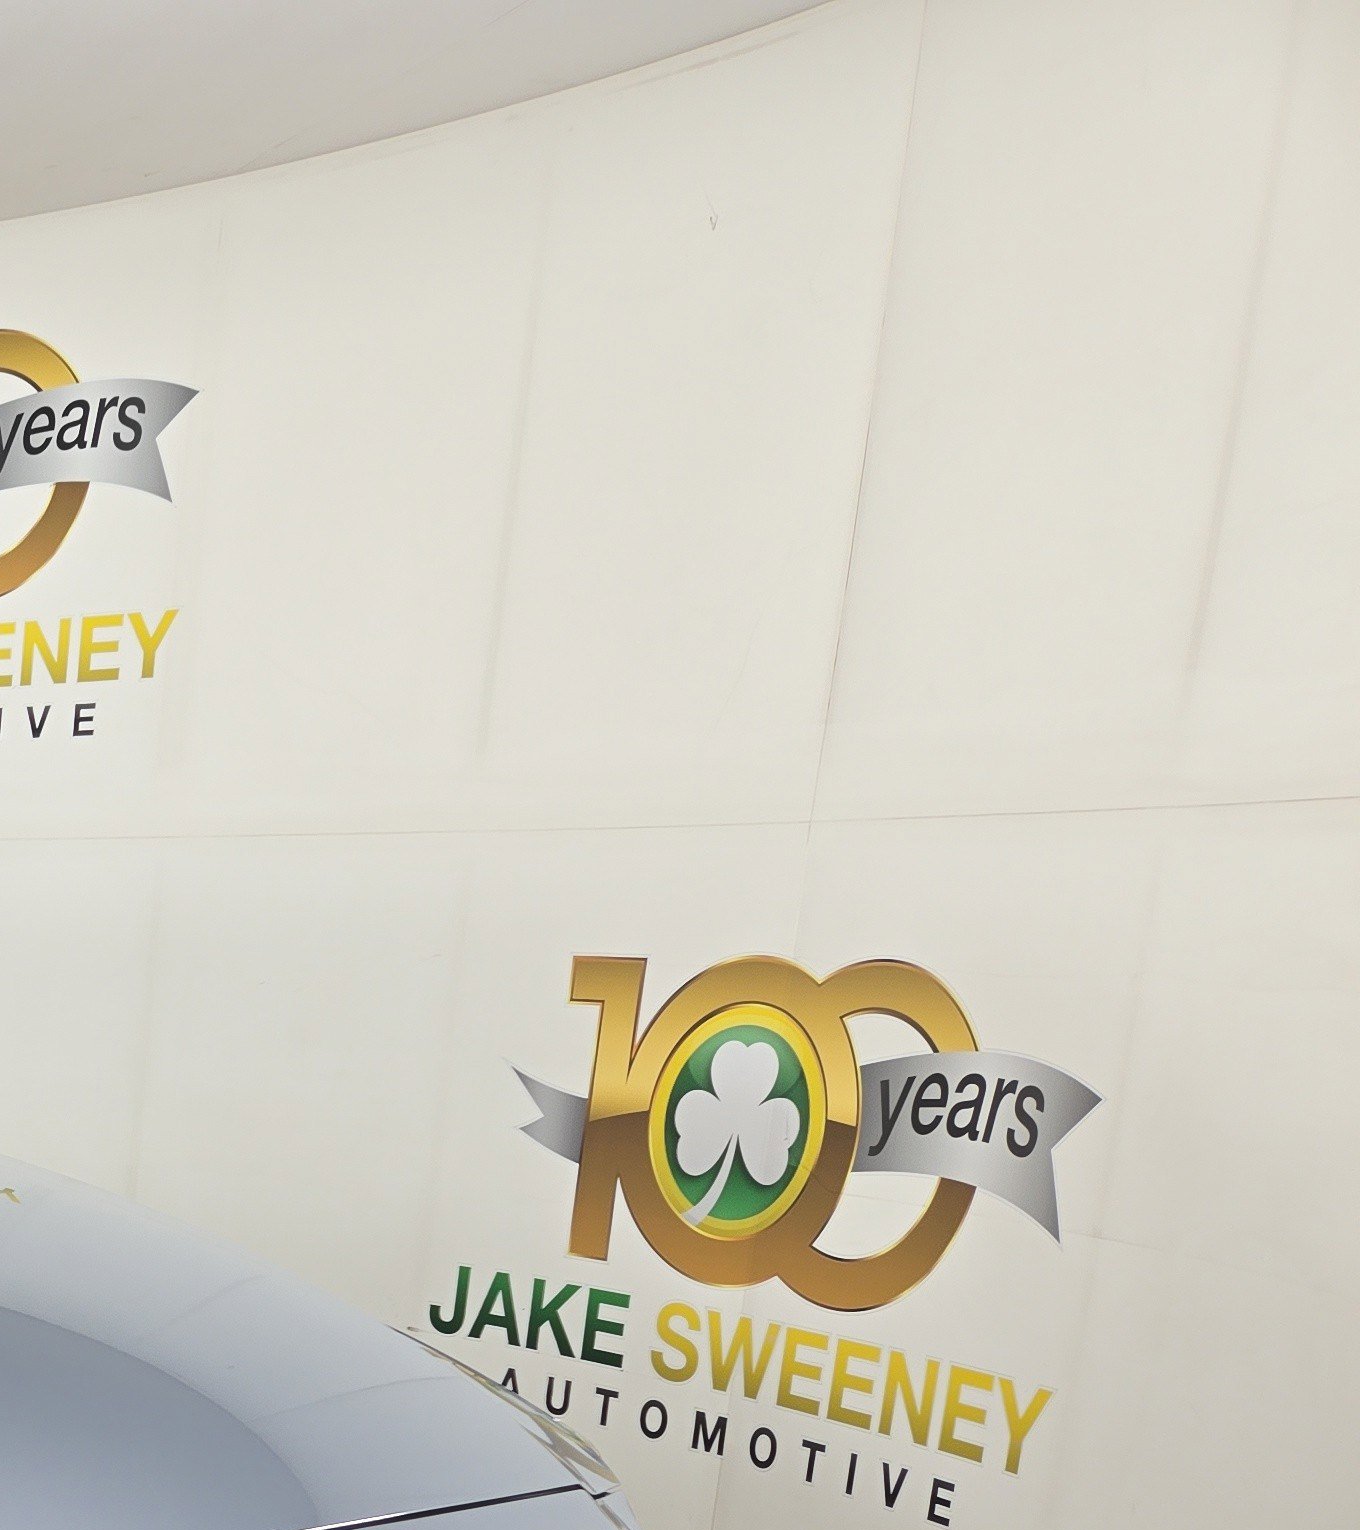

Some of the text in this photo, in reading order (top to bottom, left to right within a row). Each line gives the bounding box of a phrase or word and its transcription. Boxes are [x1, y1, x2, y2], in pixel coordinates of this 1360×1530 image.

[568, 955, 979, 1312] 100
[868, 1067, 1045, 1158] years
[429, 1265, 1055, 1474] JAKE SWEENEY
[501, 1367, 955, 1527] AUTOMOTIVE
